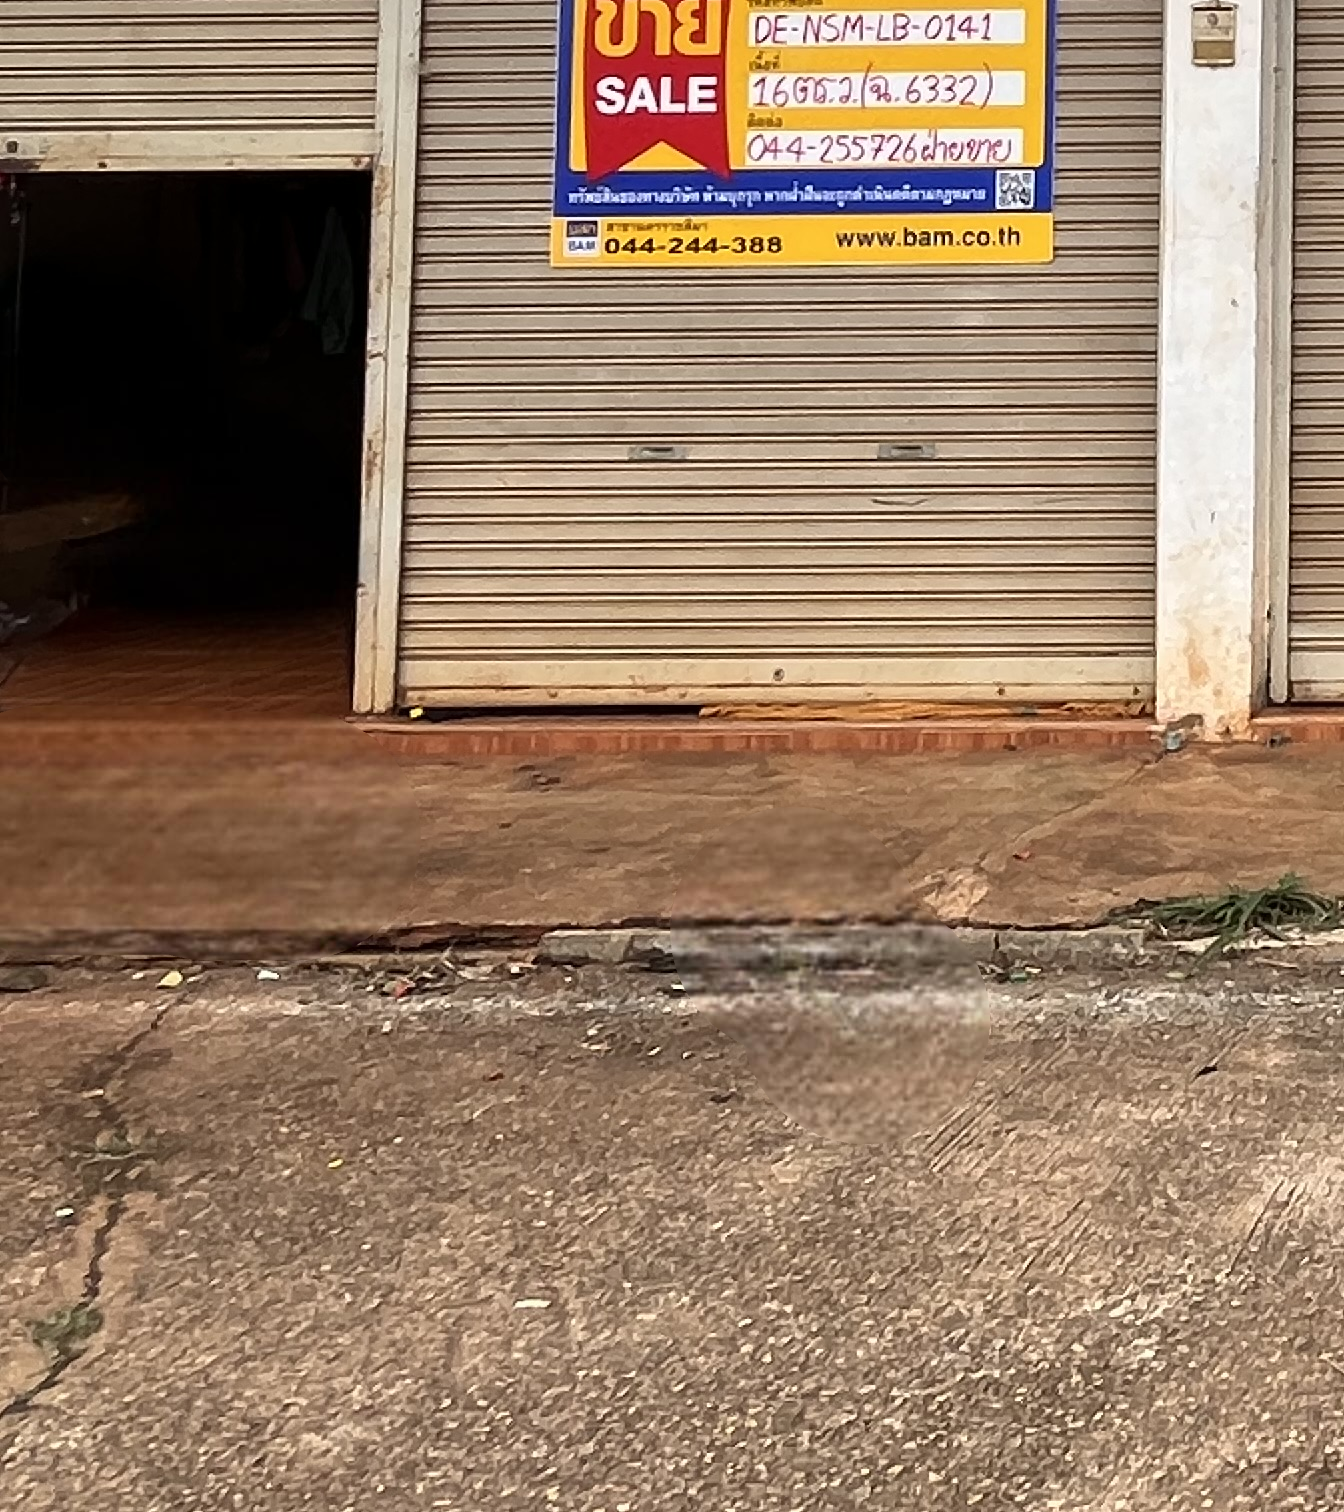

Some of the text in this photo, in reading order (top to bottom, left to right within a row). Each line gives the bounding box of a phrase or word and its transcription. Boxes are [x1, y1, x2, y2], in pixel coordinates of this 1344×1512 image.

[755, 13, 991, 43] DE-NSM-LB-0141
[595, 76, 718, 115] SALE
[568, 241, 596, 251] BAM
[604, 226, 1021, 254] 044-244-388 www.bam.co.th
